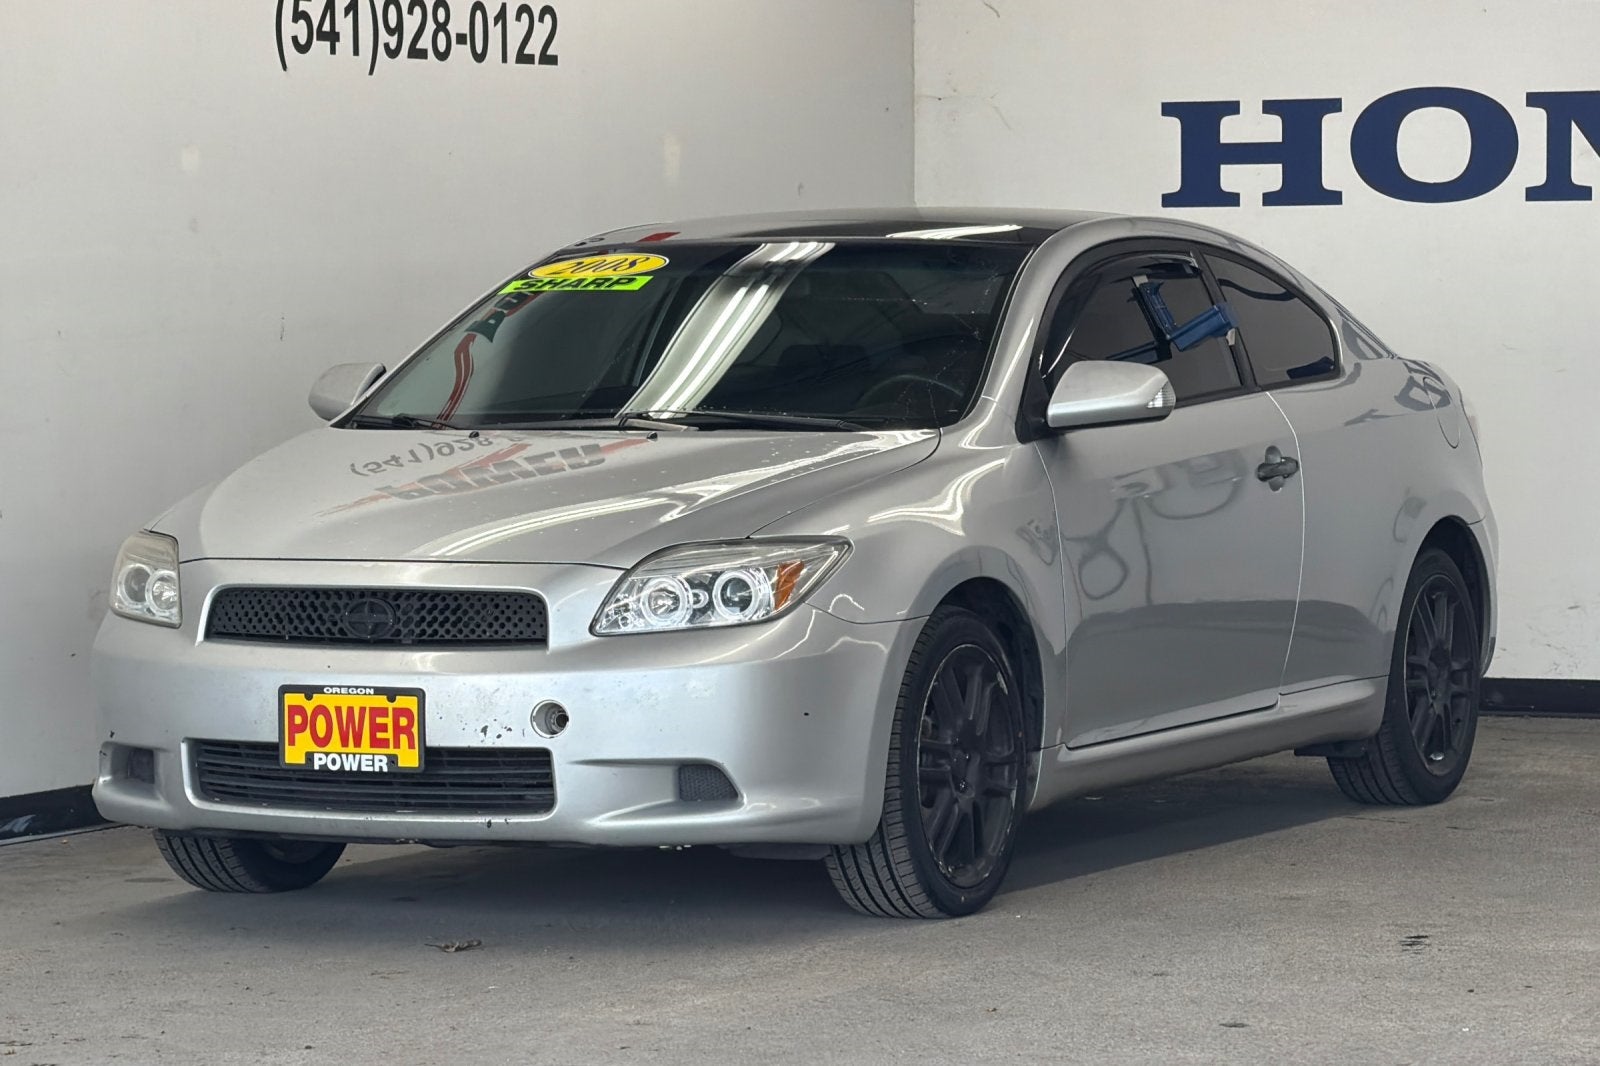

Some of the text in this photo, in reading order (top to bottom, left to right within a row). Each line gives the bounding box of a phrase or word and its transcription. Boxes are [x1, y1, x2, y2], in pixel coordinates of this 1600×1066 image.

[275, 0, 559, 76] (541)928-0122
[546, 256, 650, 276] 2008
[513, 277, 637, 291] SHARP
[323, 686, 375, 695] OREGON
[287, 704, 416, 750] POWER
[313, 752, 388, 772] POWER
